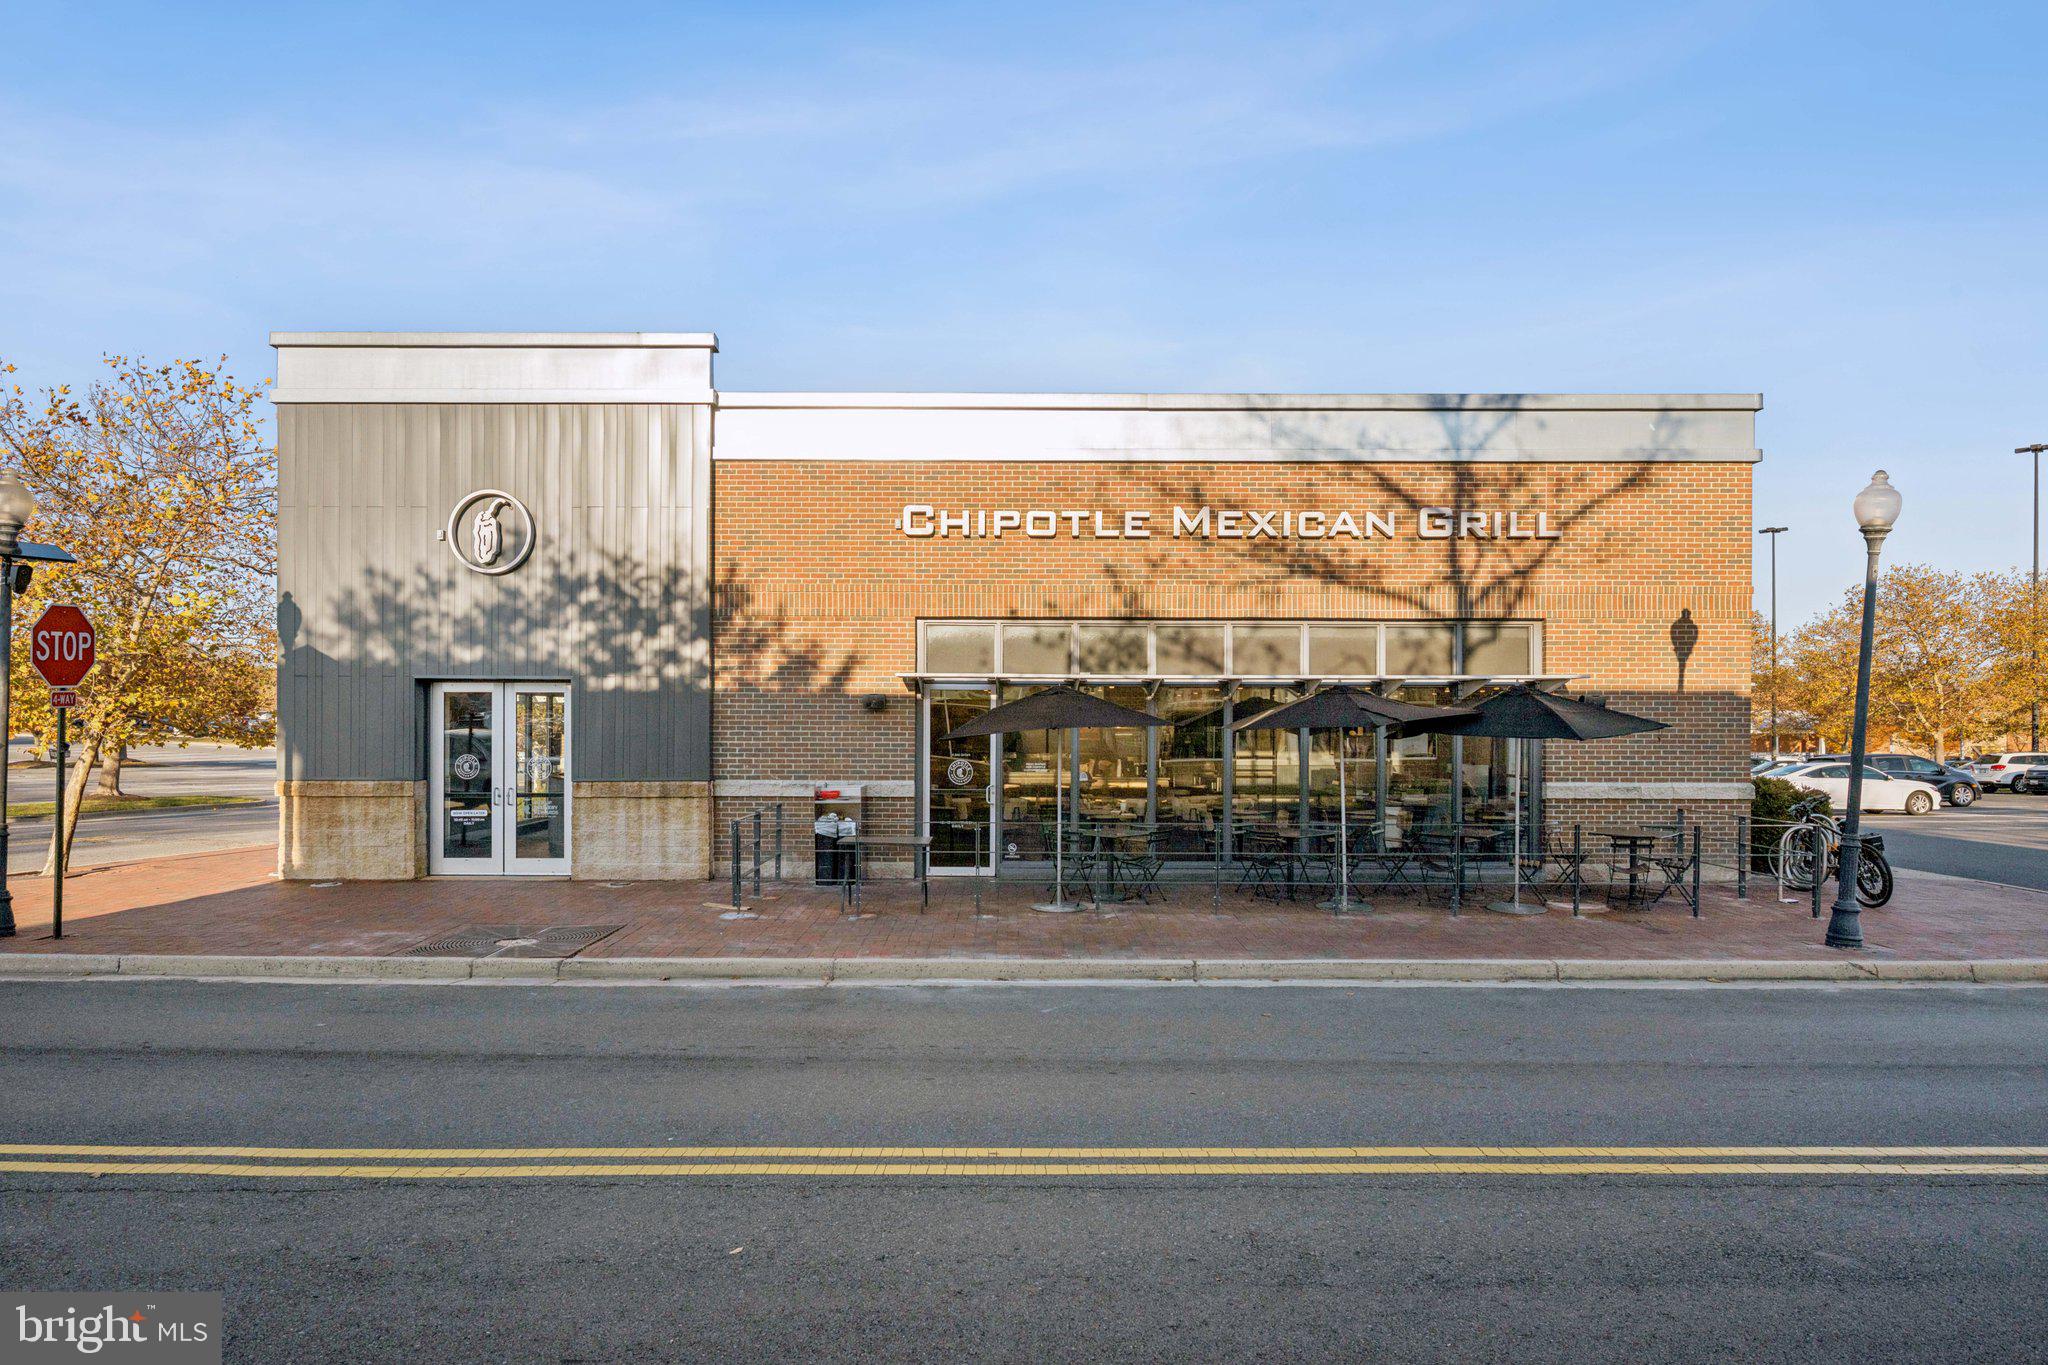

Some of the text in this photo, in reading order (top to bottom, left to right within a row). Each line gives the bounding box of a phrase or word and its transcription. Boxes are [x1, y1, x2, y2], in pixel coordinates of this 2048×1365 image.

[902, 504, 1563, 539] CHIPOTLE MEXICAN GRILL
[36, 631, 92, 661] STOP
[52, 694, 76, 704] 4-WAY
